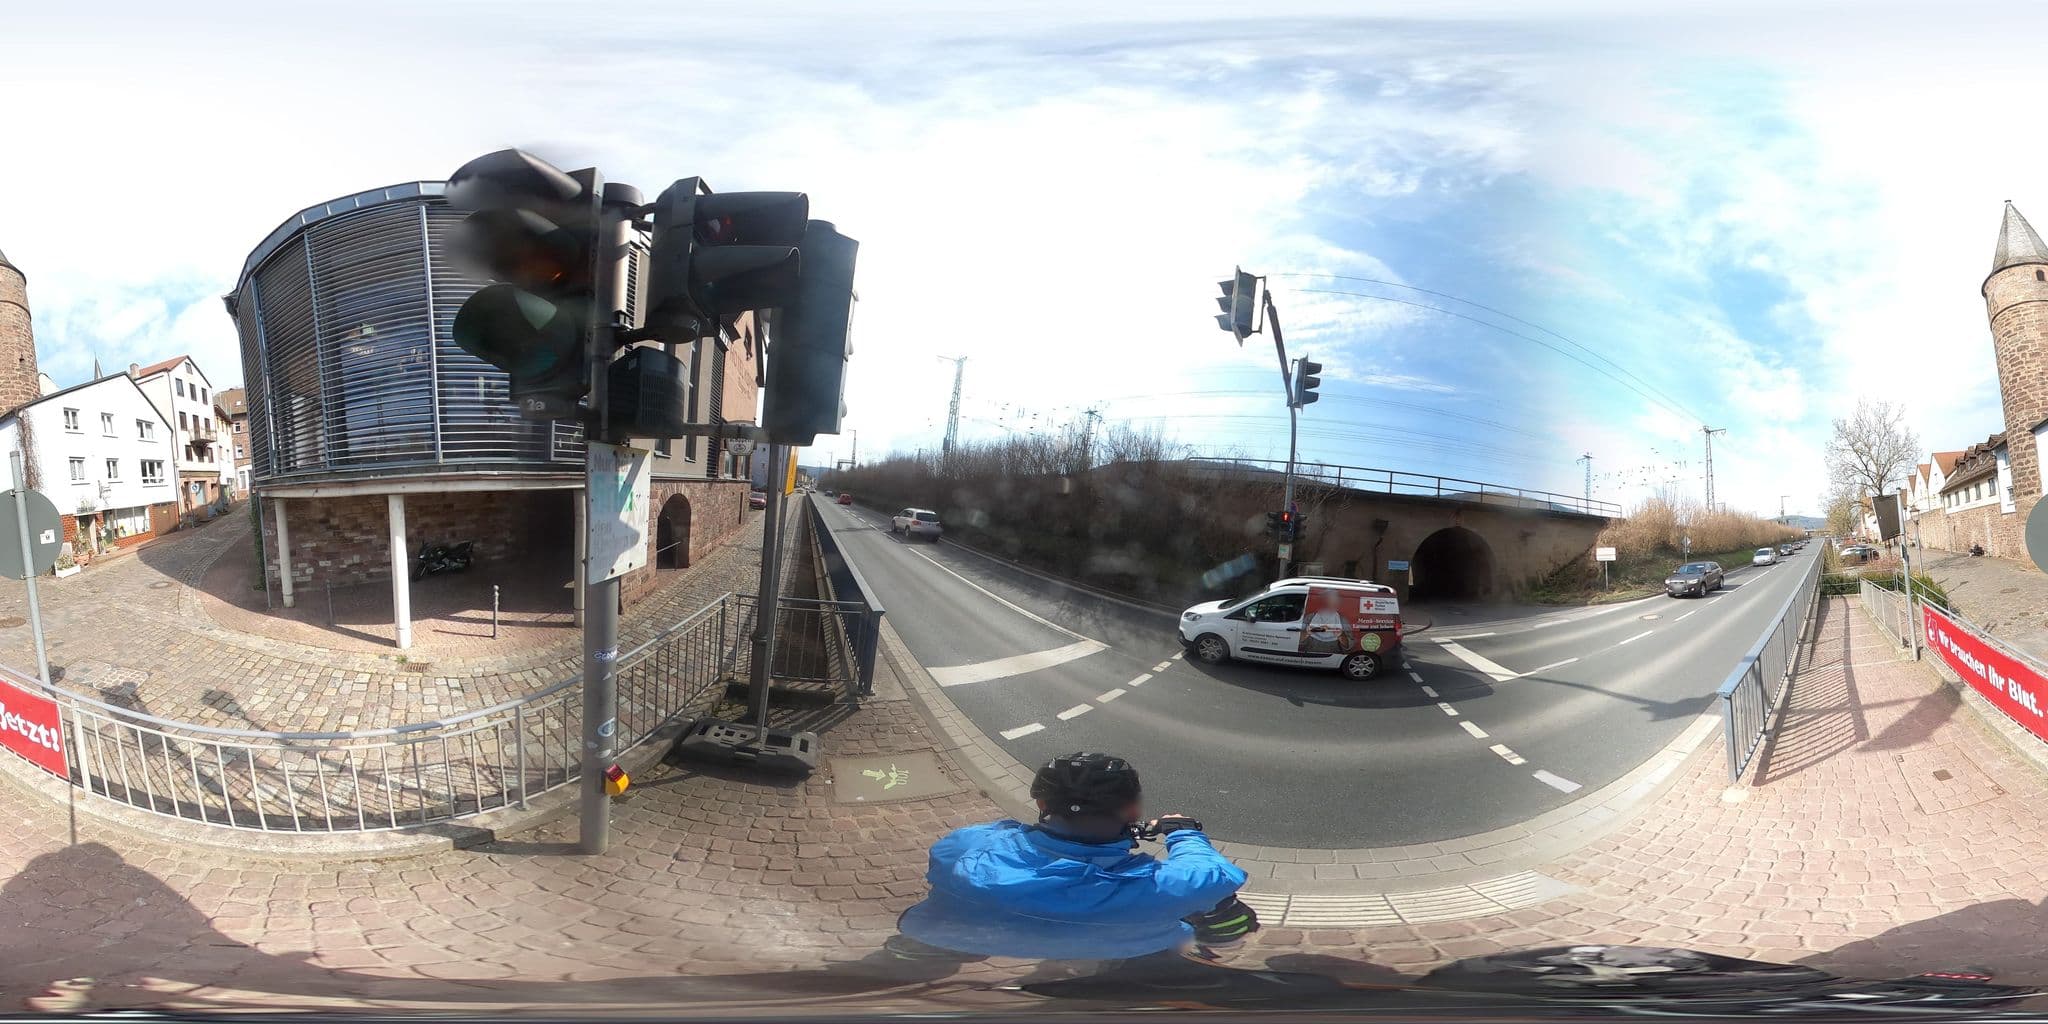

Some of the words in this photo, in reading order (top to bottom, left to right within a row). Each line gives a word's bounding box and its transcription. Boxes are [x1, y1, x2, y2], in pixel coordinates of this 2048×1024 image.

[1938, 629, 1949, 648] Wir
[1950, 637, 1986, 679] brauchen
[1988, 665, 2004, 691] Ihr
[2008, 677, 2044, 718] Blut.
